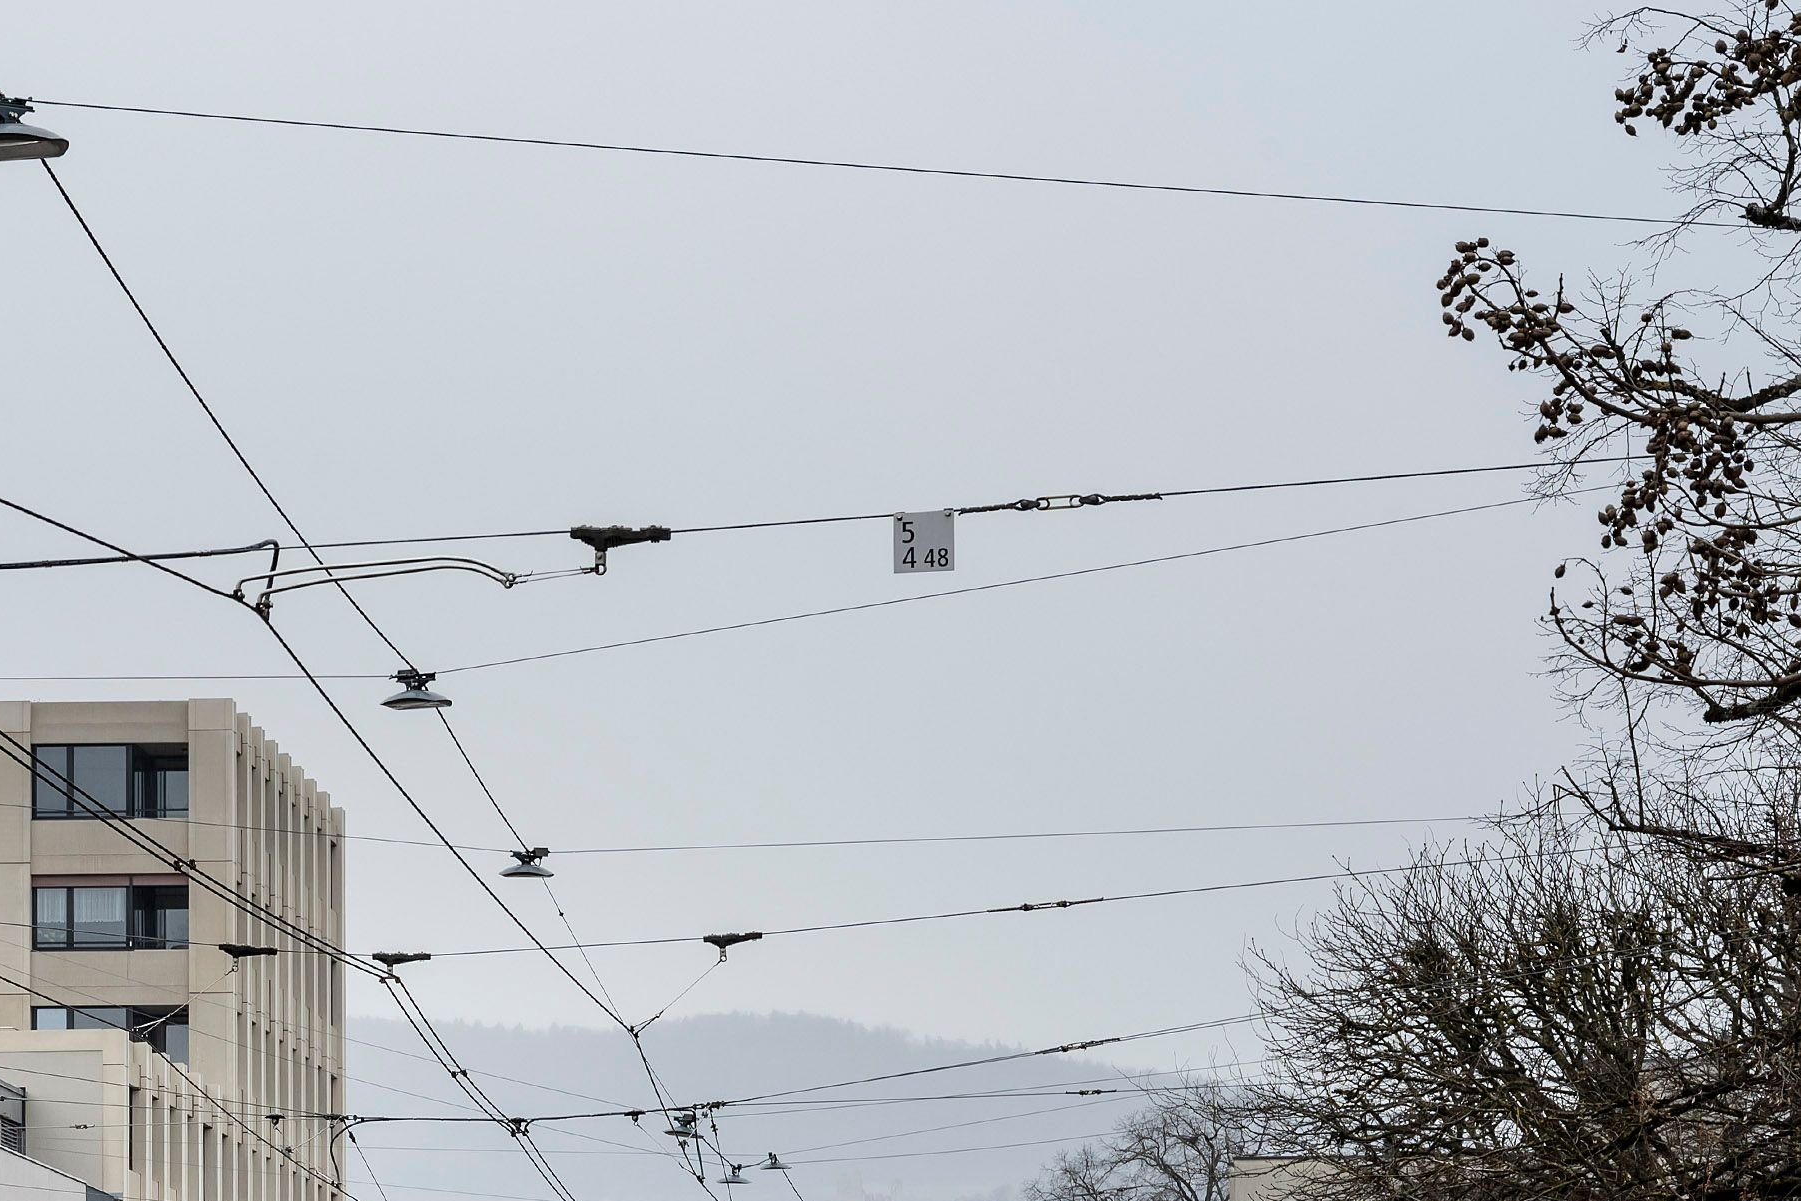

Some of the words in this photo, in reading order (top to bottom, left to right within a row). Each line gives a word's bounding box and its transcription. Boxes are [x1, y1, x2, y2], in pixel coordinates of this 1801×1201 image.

[902, 521, 915, 543] 5
[902, 547, 917, 568] 4
[924, 548, 949, 567] 48
